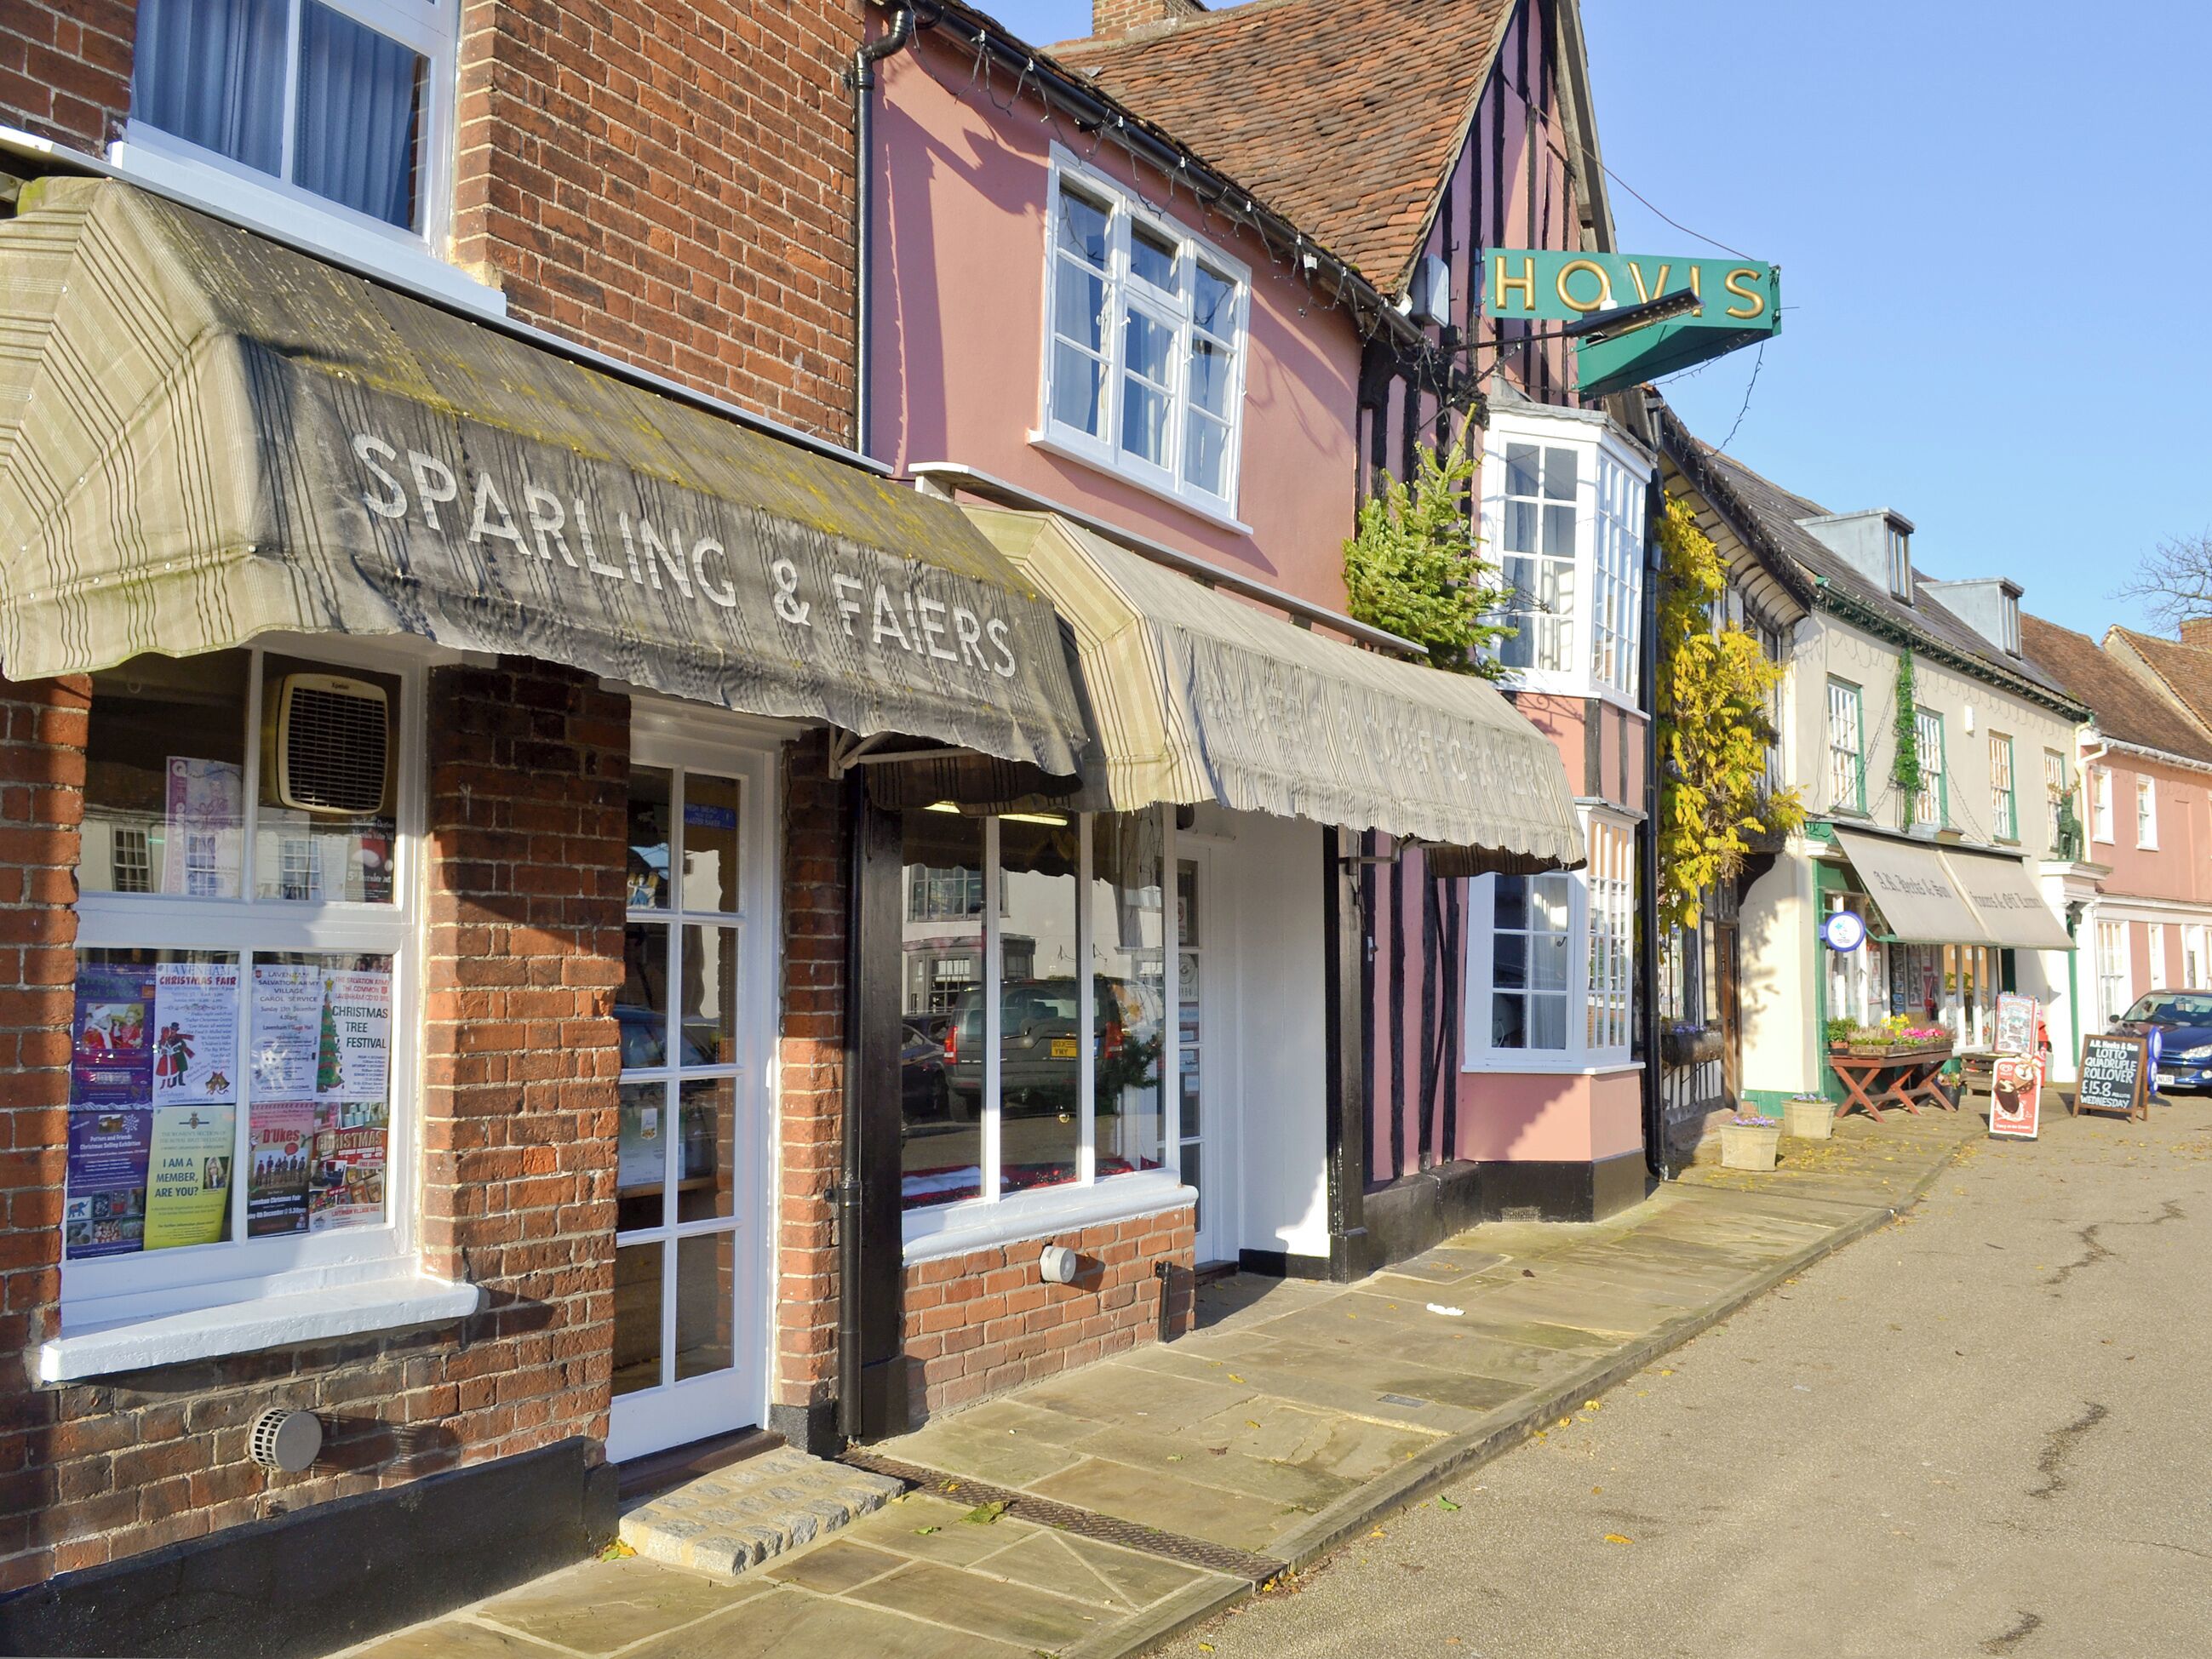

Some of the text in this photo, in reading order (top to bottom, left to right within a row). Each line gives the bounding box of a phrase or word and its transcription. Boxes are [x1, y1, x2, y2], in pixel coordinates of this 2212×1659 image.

[1494, 255, 1766, 320] HOVIS
[351, 432, 1017, 678] SPARLING & FAIERS
[159, 975, 213, 986] CHRISTMAS
[215, 976, 237, 986] FAIR
[332, 1005, 388, 1019] CHRISTMAS
[346, 1021, 368, 1033] TREE
[346, 1038, 387, 1049] FESTIVAL
[2095, 1049, 2128, 1060] LOTTO
[2084, 1056, 2138, 1073] QUADRUPLE
[2083, 1067, 2135, 1084] ROLLOVER
[2081, 1079, 2112, 1097] £15.8
[2080, 1095, 2130, 1108] WEDNESDAY
[262, 1128, 301, 1144] D'Ukes
[316, 1130, 383, 1152] CHRISTMAS
[163, 1157, 193, 1168] I AM A
[156, 1172, 198, 1183] MEMBER,
[154, 1186, 199, 1198] ARE YOU?
